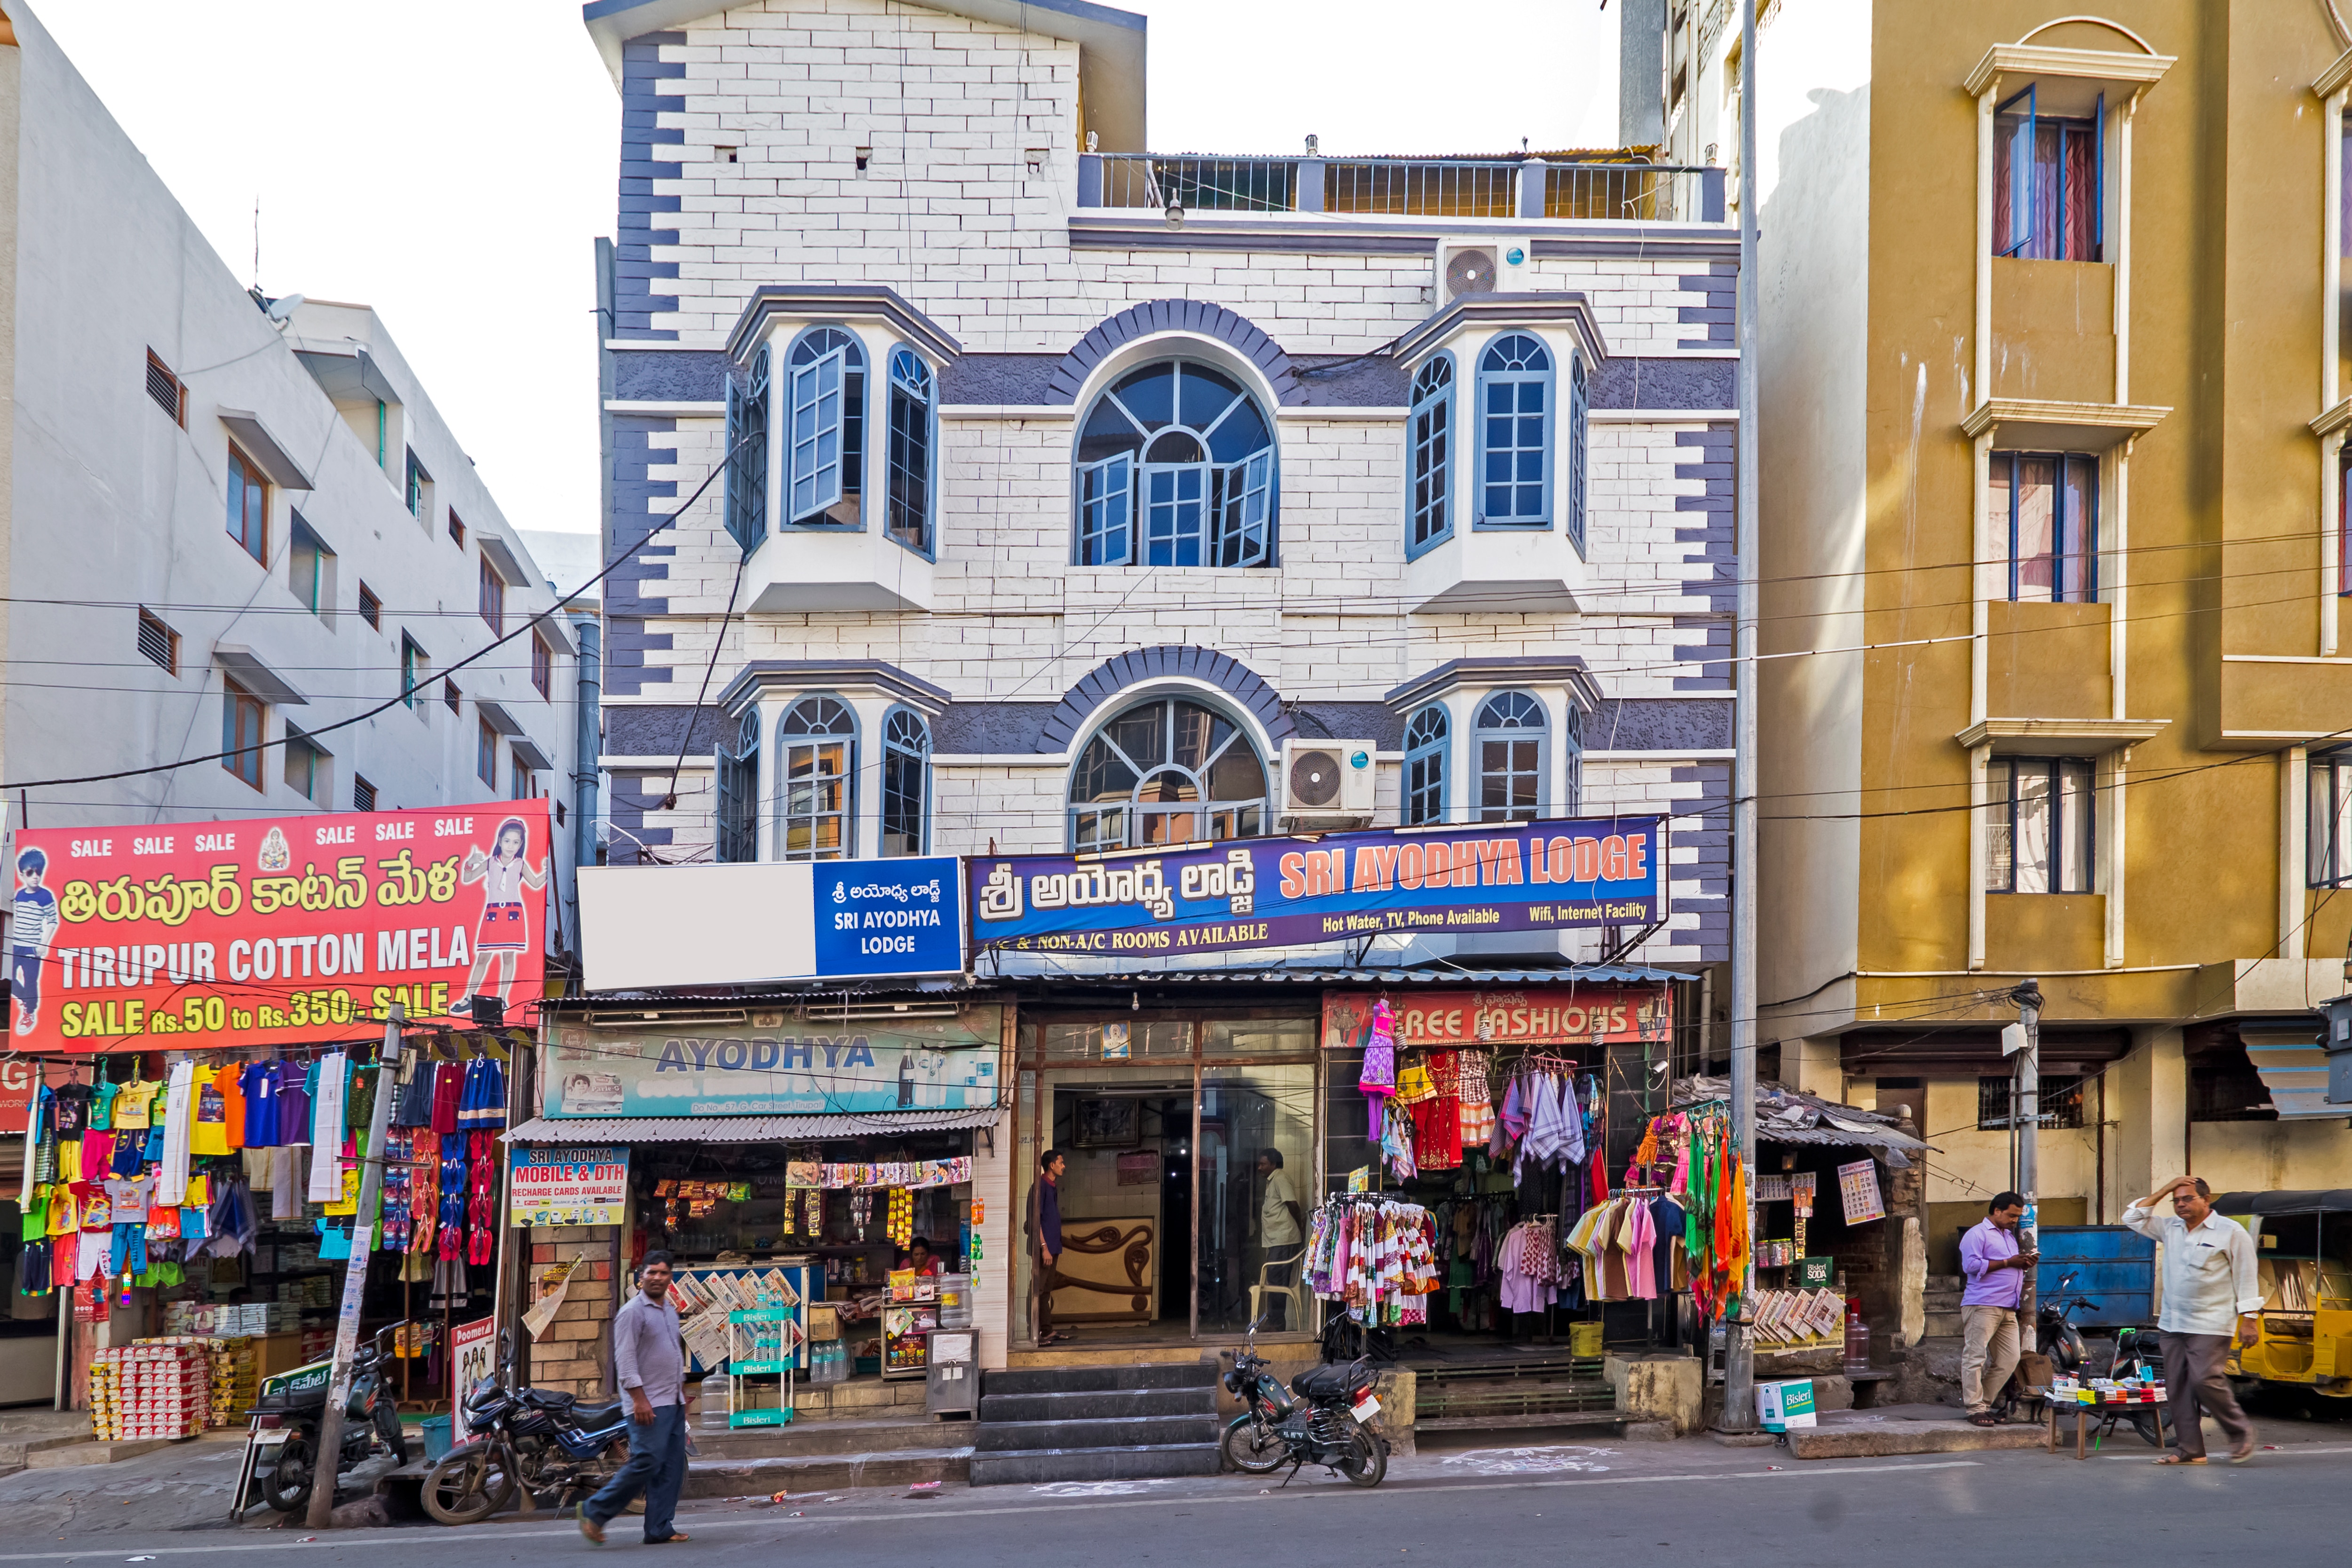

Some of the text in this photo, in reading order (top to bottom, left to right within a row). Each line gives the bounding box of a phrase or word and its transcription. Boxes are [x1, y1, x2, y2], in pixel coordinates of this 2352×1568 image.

[71, 817, 473, 858] SALE SALE SALE SALE SALE SALE
[1279, 833, 1647, 899] SRI AYODHYA LODGE
[60, 848, 460, 926] తిరుపూర్ కాటన్ మేళ
[832, 881, 847, 903] శ్రీ
[850, 884, 908, 903] అయోధ్య
[979, 849, 1254, 920] శ్రీ అయోధ్య లాడ్జి
[834, 909, 941, 930] SRI AYODHYA
[1323, 908, 1500, 932] Hot Water, TV, Phone Available
[1529, 902, 1647, 923] Wifi, Internet Facility
[861, 936, 915, 954] LODGE
[1017, 937, 1031, 949] &
[1037, 933, 1105, 951] NON-A/C
[1112, 931, 1170, 948] ROOMS
[1176, 923, 1268, 947] AVAILABLE
[57, 925, 470, 988] TIRUPUR COTTON MELA
[1472, 991, 1483, 1006] శ్రీ
[62, 1000, 145, 1037] SALE
[151, 996, 225, 1035] Rs.50
[232, 1008, 253, 1029] to
[373, 982, 449, 1020] SALE
[1397, 1010, 1462, 1036] REE
[656, 1034, 875, 1073] AYODHYA
[2, 1060, 27, 1090] G
[795, 1100, 824, 1110] Tirupati
[529, 1149, 613, 1163] SRI AYODHYA
[515, 1164, 625, 1183] MOBILE & DTH
[512, 1186, 621, 1196] RECHARGE CARDS AVAILABLE
[1807, 1271, 1827, 1279] SODA
[689, 1280, 708, 1300] Chronicle
[457, 1326, 485, 1344] Poomer
[1787, 1389, 1811, 1405] Bisleri
